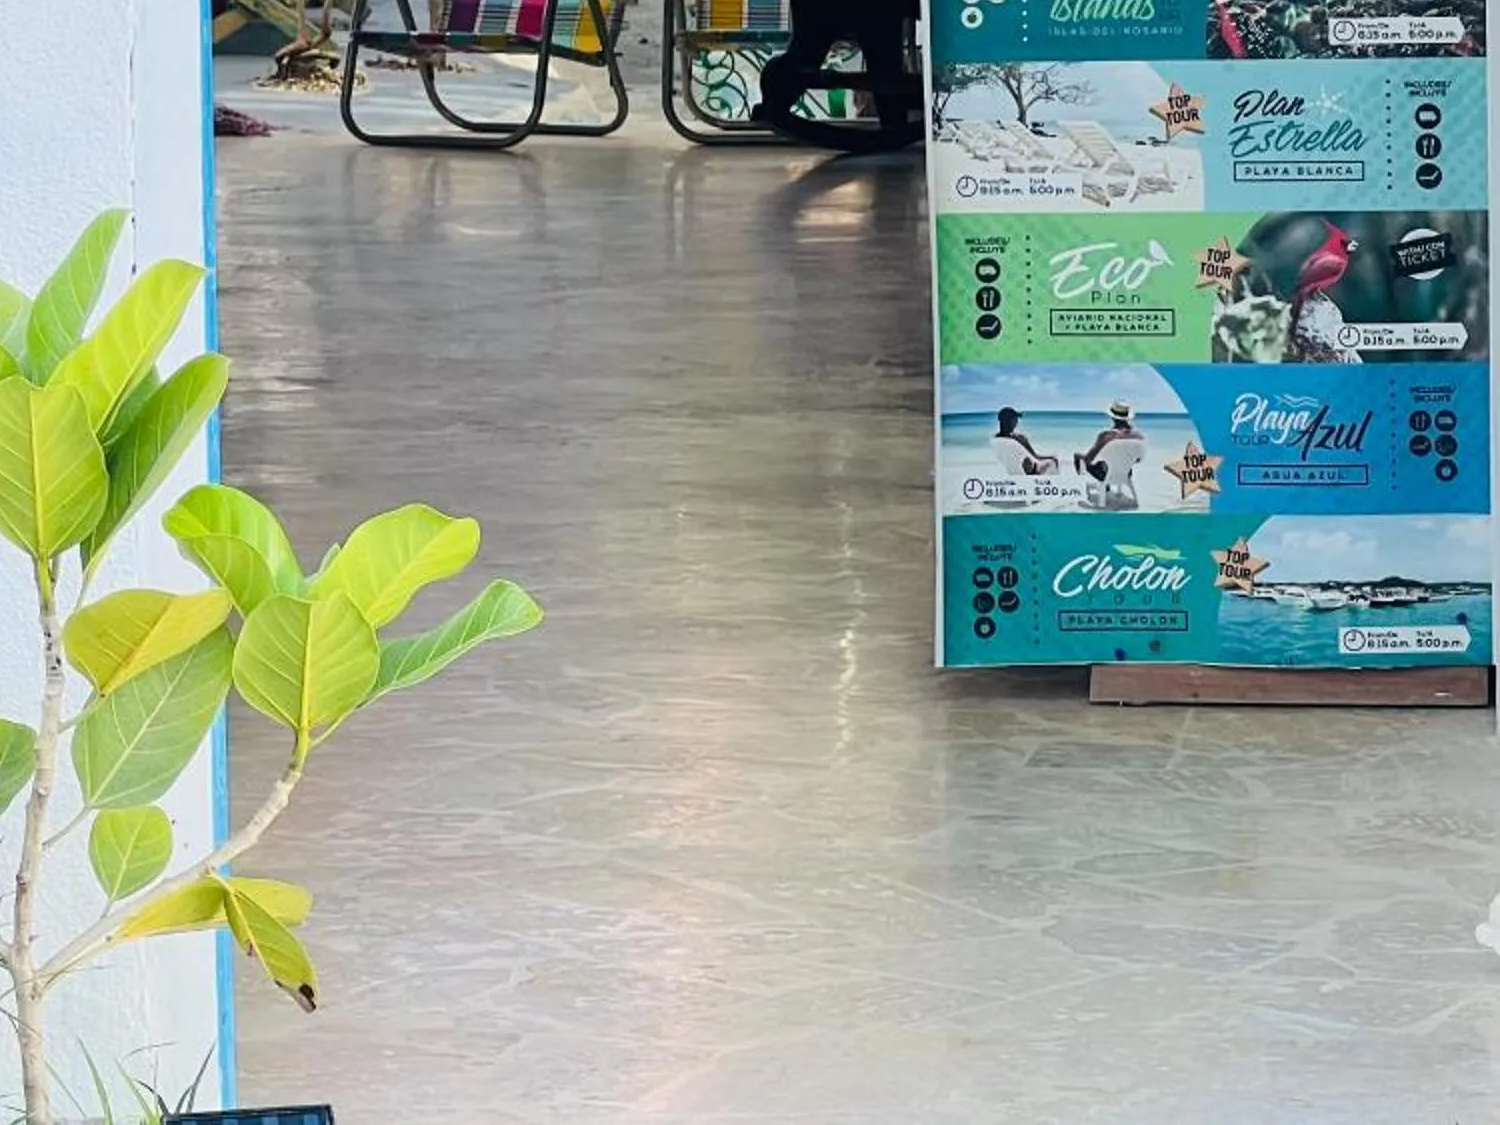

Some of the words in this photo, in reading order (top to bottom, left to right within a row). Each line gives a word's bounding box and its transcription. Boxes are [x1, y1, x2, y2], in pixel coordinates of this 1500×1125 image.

[1167, 94, 1191, 109] TOP
[1233, 89, 1305, 123] Plan
[1166, 108, 1200, 125] TOUR
[1228, 119, 1368, 158] Estrella
[1244, 166, 1291, 176] PLAYA
[1297, 166, 1354, 176] BLANCA
[1206, 248, 1231, 263] TOP
[1399, 248, 1445, 268] TICKET
[1050, 242, 1153, 299] Eco
[1200, 262, 1233, 280] TOUR
[1091, 290, 1141, 305] Plan
[1057, 314, 1105, 322] AVIARIO
[1109, 314, 1167, 322] NACIONAL
[1075, 324, 1111, 332] PLAYA
[1115, 324, 1160, 332] BLANCA
[1231, 393, 1312, 444] Playa
[1285, 405, 1374, 461] Azul
[1183, 454, 1207, 468] TOP
[1181, 467, 1215, 484] TOUR
[1307, 470, 1346, 480] AZUL
[1226, 549, 1250, 565] TOP
[1052, 553, 1192, 597] Cholon
[1218, 562, 1252, 579] TOUR
[1067, 616, 1113, 625] PLAYA
[1119, 616, 1178, 625] CHOLON
